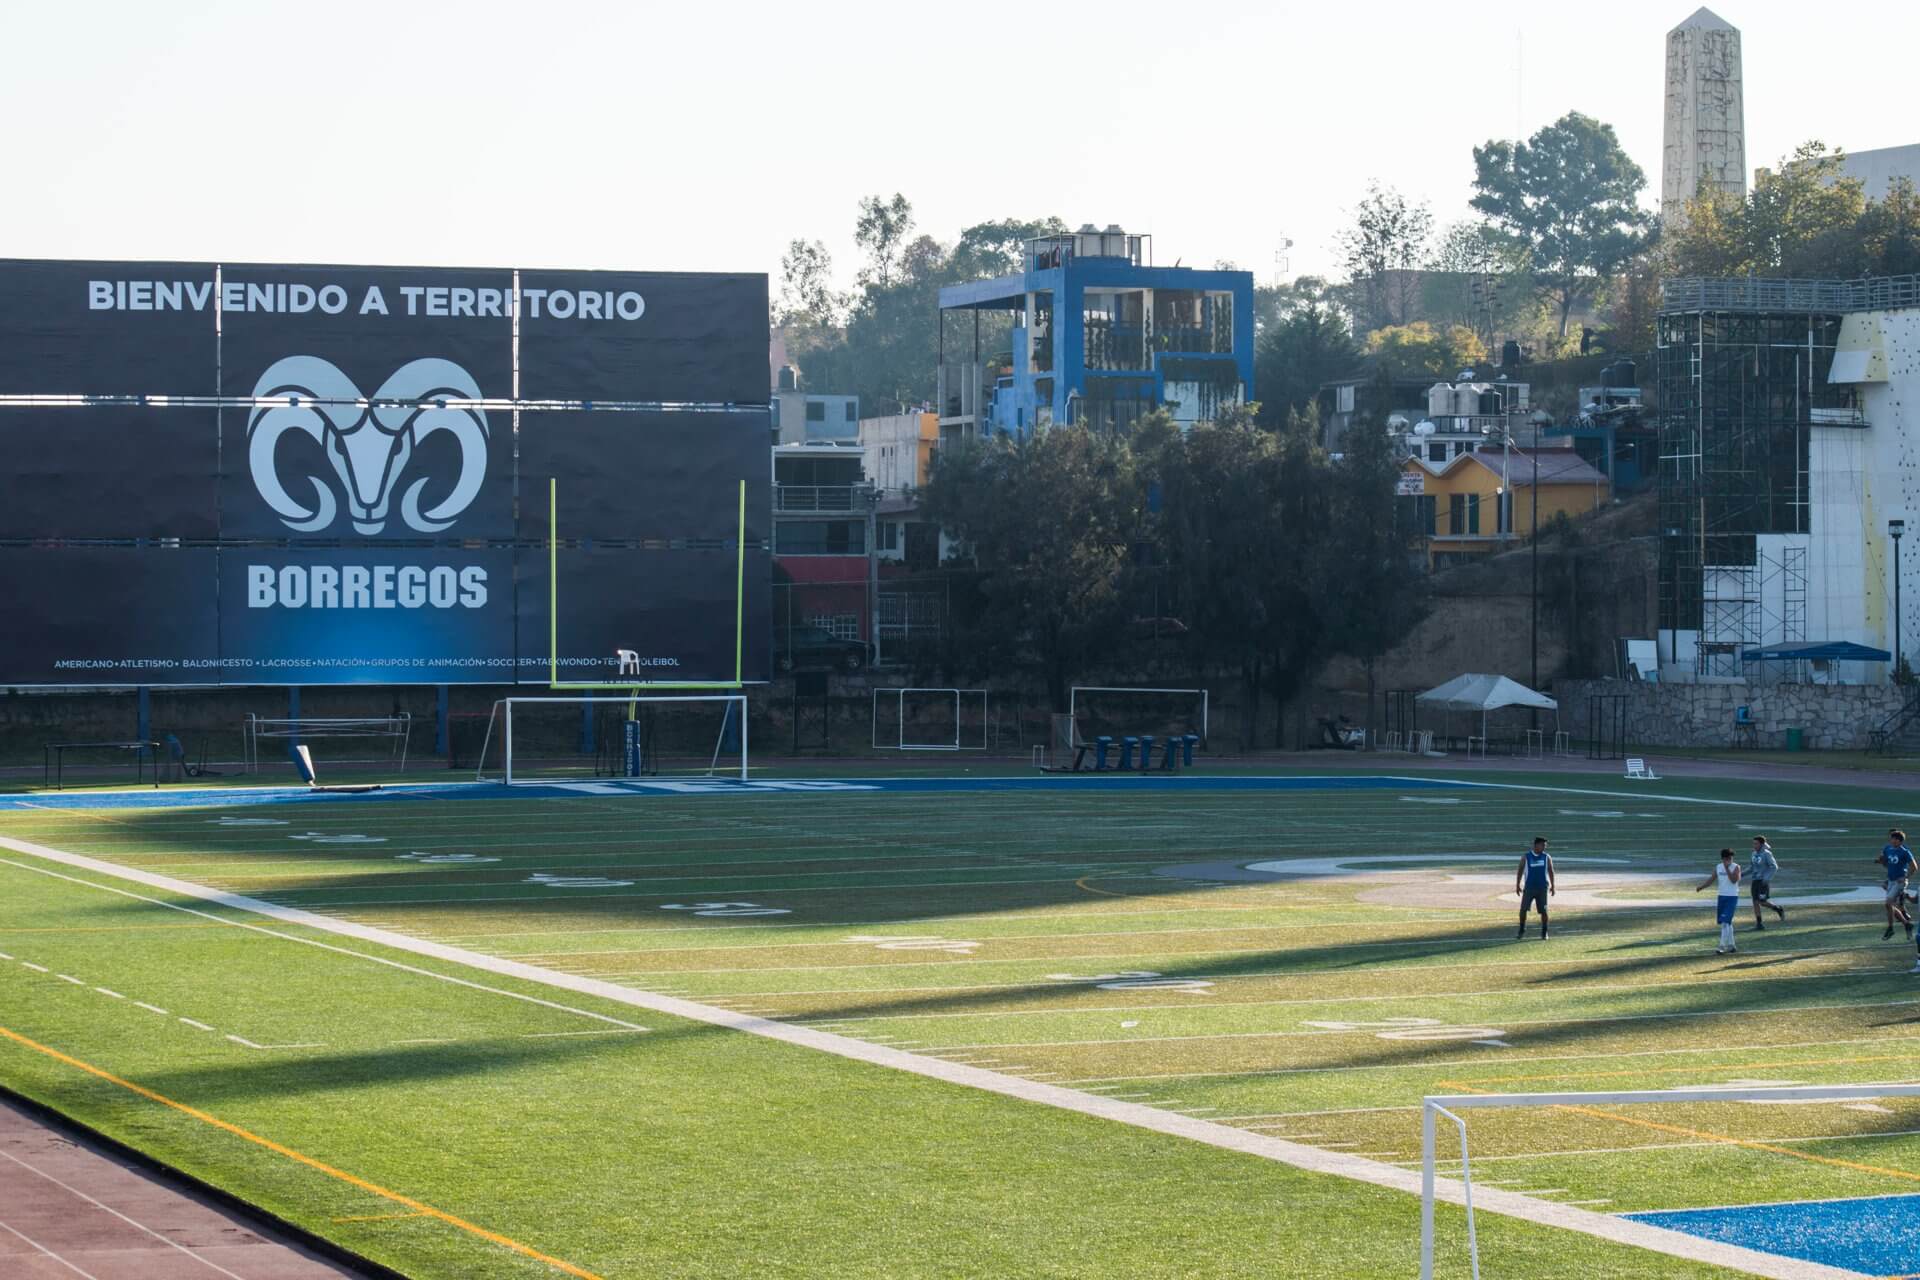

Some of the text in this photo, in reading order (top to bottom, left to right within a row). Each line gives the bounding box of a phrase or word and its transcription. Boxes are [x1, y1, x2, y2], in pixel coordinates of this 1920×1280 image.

[88, 280, 646, 321] BIENVENIDO A TERRITORIO
[248, 564, 488, 609] BORREGOS
[54, 659, 114, 669] AMERICANO
[119, 659, 174, 668] ATLETISMO
[261, 658, 312, 668] LACROSSE
[316, 657, 366, 667] NATACIÓN
[371, 658, 410, 667] GRUPOS
[412, 658, 425, 667] DE
[428, 656, 482, 667] ANIMACIÓN
